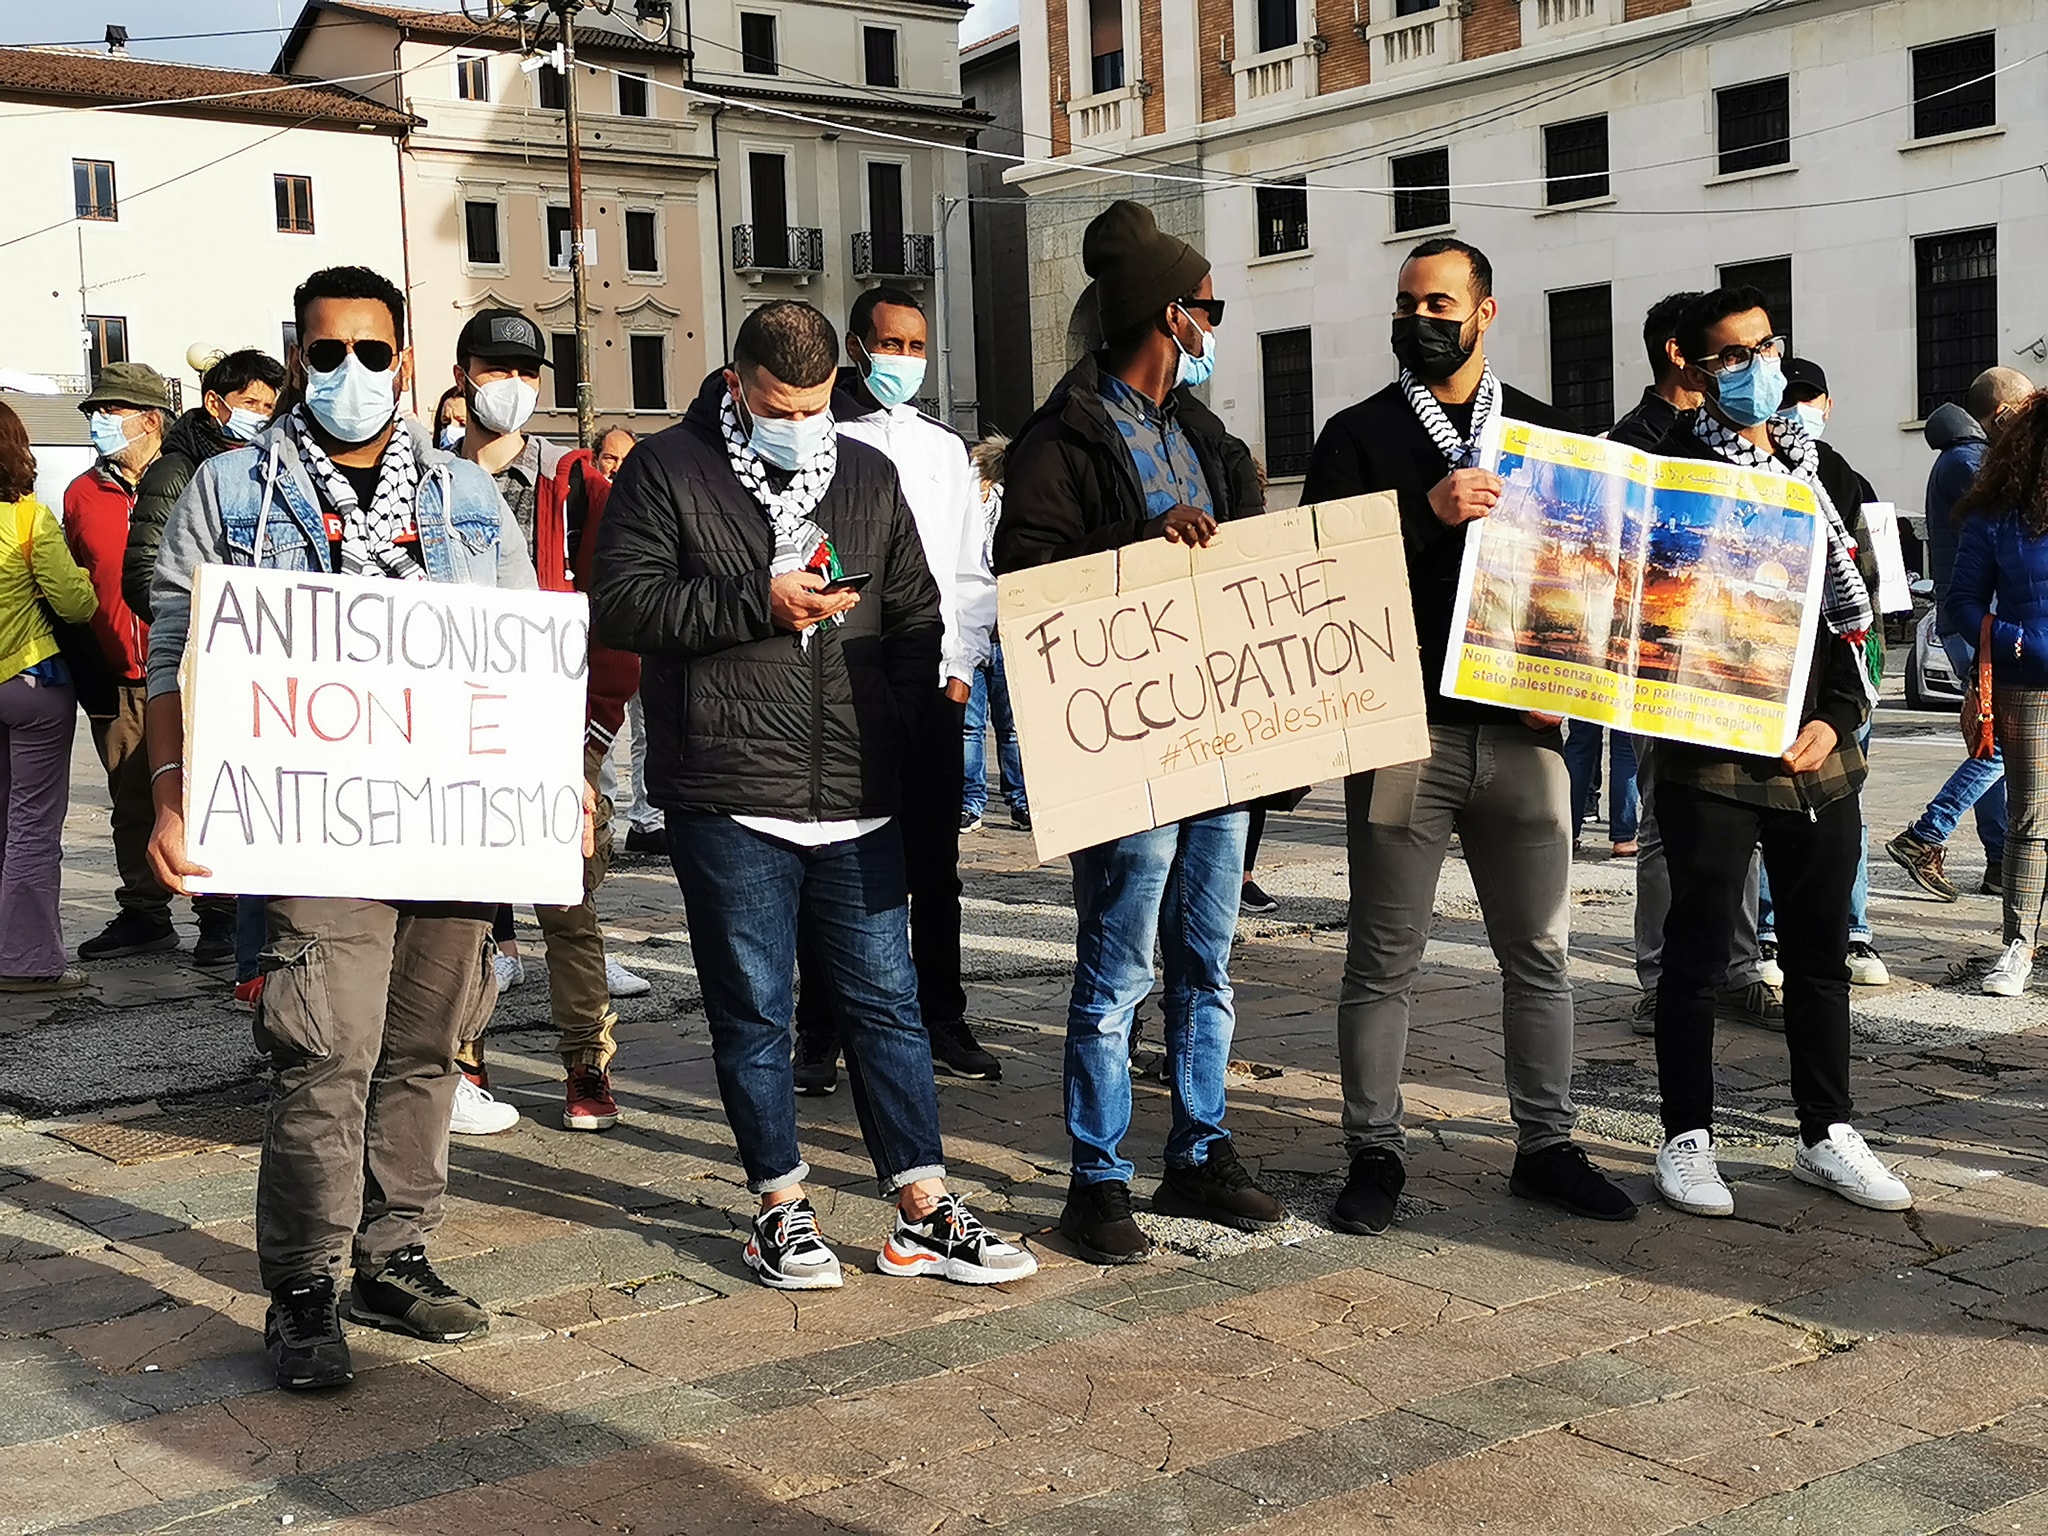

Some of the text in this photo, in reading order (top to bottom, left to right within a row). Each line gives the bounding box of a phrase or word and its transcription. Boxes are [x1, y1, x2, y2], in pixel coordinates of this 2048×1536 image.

[205, 581, 588, 680] ANTISIONISMO
[1025, 558, 1346, 684] FUCK THE
[252, 677, 508, 754] NON È
[1066, 607, 1396, 753] OCCUPATION
[1464, 648, 1491, 663] Non
[1517, 660, 1550, 674] pace
[1554, 666, 1592, 682] senza
[1653, 687, 1725, 709] palestinese
[1472, 669, 1507, 684] stato
[1510, 676, 1588, 699] palestinese
[200, 760, 580, 847] ANTISEMITISMO
